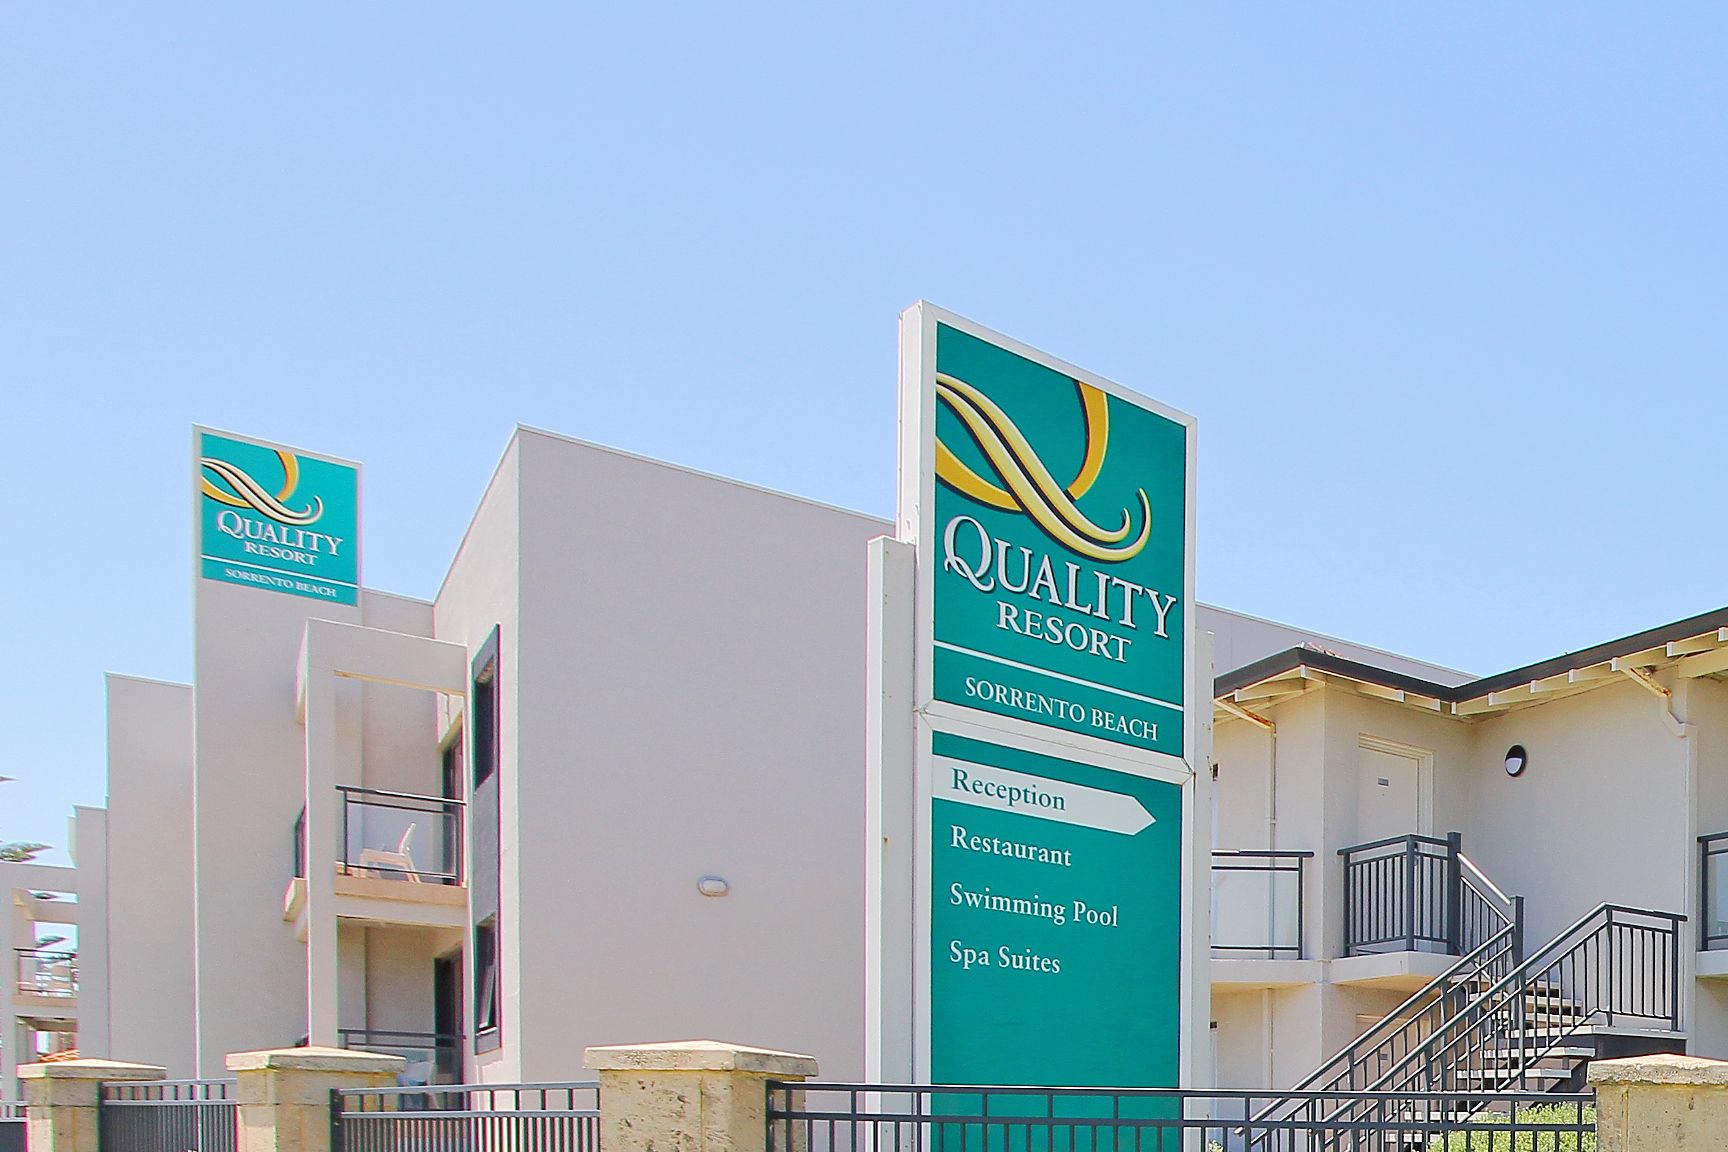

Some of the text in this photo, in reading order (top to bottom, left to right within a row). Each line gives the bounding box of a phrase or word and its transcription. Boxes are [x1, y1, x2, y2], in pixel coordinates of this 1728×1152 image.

[217, 511, 343, 556] QUALITY
[244, 541, 317, 566] RESORT
[225, 568, 337, 598] SORRENTO BEACH
[944, 515, 1176, 640] QUALITY
[996, 601, 1131, 664] RESORT
[965, 676, 1158, 742] SORRENTO BEACH
[951, 767, 1066, 812] Reception
[951, 825, 1072, 867] Restaurant
[950, 882, 1119, 927] Swimming Pool
[950, 940, 1061, 974] Spa Suites
